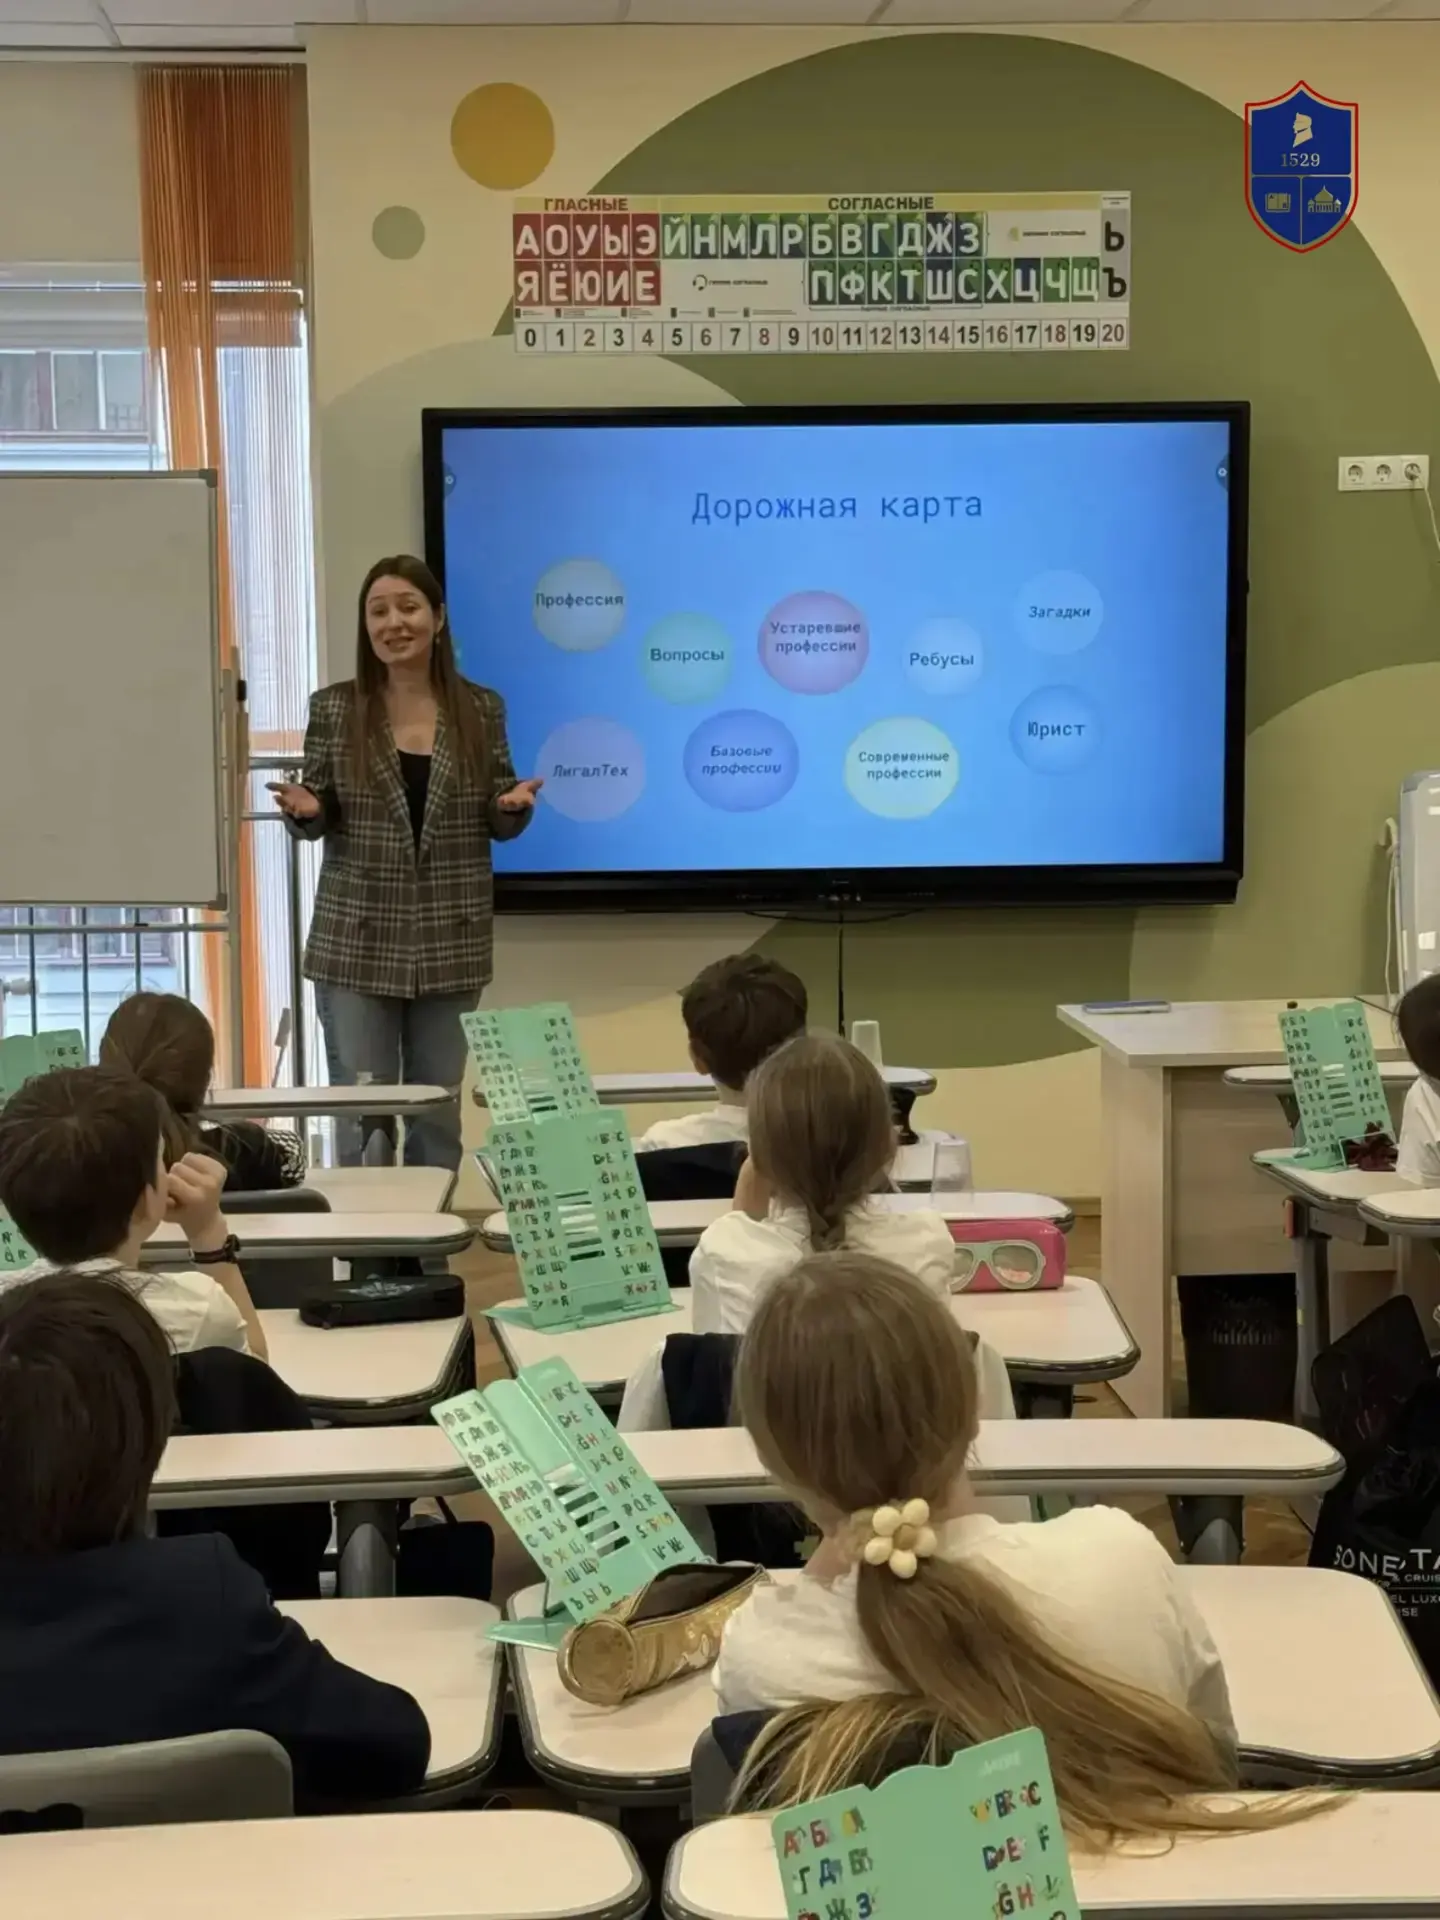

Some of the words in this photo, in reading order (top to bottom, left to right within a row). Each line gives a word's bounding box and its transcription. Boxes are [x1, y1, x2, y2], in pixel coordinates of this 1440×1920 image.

[544, 198, 629, 211] ГЛАСНЫЕ
[828, 196, 934, 210] СОГЛАСНЫЕ
[525, 328, 536, 347] 0
[556, 328, 565, 347] 1
[583, 328, 596, 347] 2
[613, 328, 624, 347] 3
[641, 328, 654, 347] 4
[671, 328, 683, 346] 5
[700, 328, 712, 346] 6
[729, 328, 742, 346] 7
[758, 328, 770, 346] 8
[788, 328, 799, 346] 9
[811, 327, 834, 345] 10
[842, 327, 863, 345] 11
[869, 327, 892, 345] 12
[899, 327, 922, 345] 13
[928, 326, 950, 344] 14
[956, 326, 980, 344] 15
[985, 326, 1008, 343] 16
[1014, 326, 1037, 343] 17
[1044, 325, 1066, 343] 18
[1072, 325, 1096, 343] 19
[1102, 324, 1125, 342] 20
[691, 492, 857, 526] Дорожная
[881, 495, 982, 523] карта
[535, 593, 624, 608] Профессия
[1028, 605, 1091, 620] Загадки
[770, 621, 861, 637] Устаревшие
[775, 640, 856, 655] профессии
[650, 649, 725, 664] Вопросы
[909, 652, 974, 669] Ребусы
[1027, 720, 1087, 740] Юрист
[710, 745, 773, 758] Базовые
[858, 751, 950, 765] Современные
[553, 763, 629, 779] ЛигалТех
[702, 761, 782, 776] профессии
[867, 767, 942, 782] профессии
